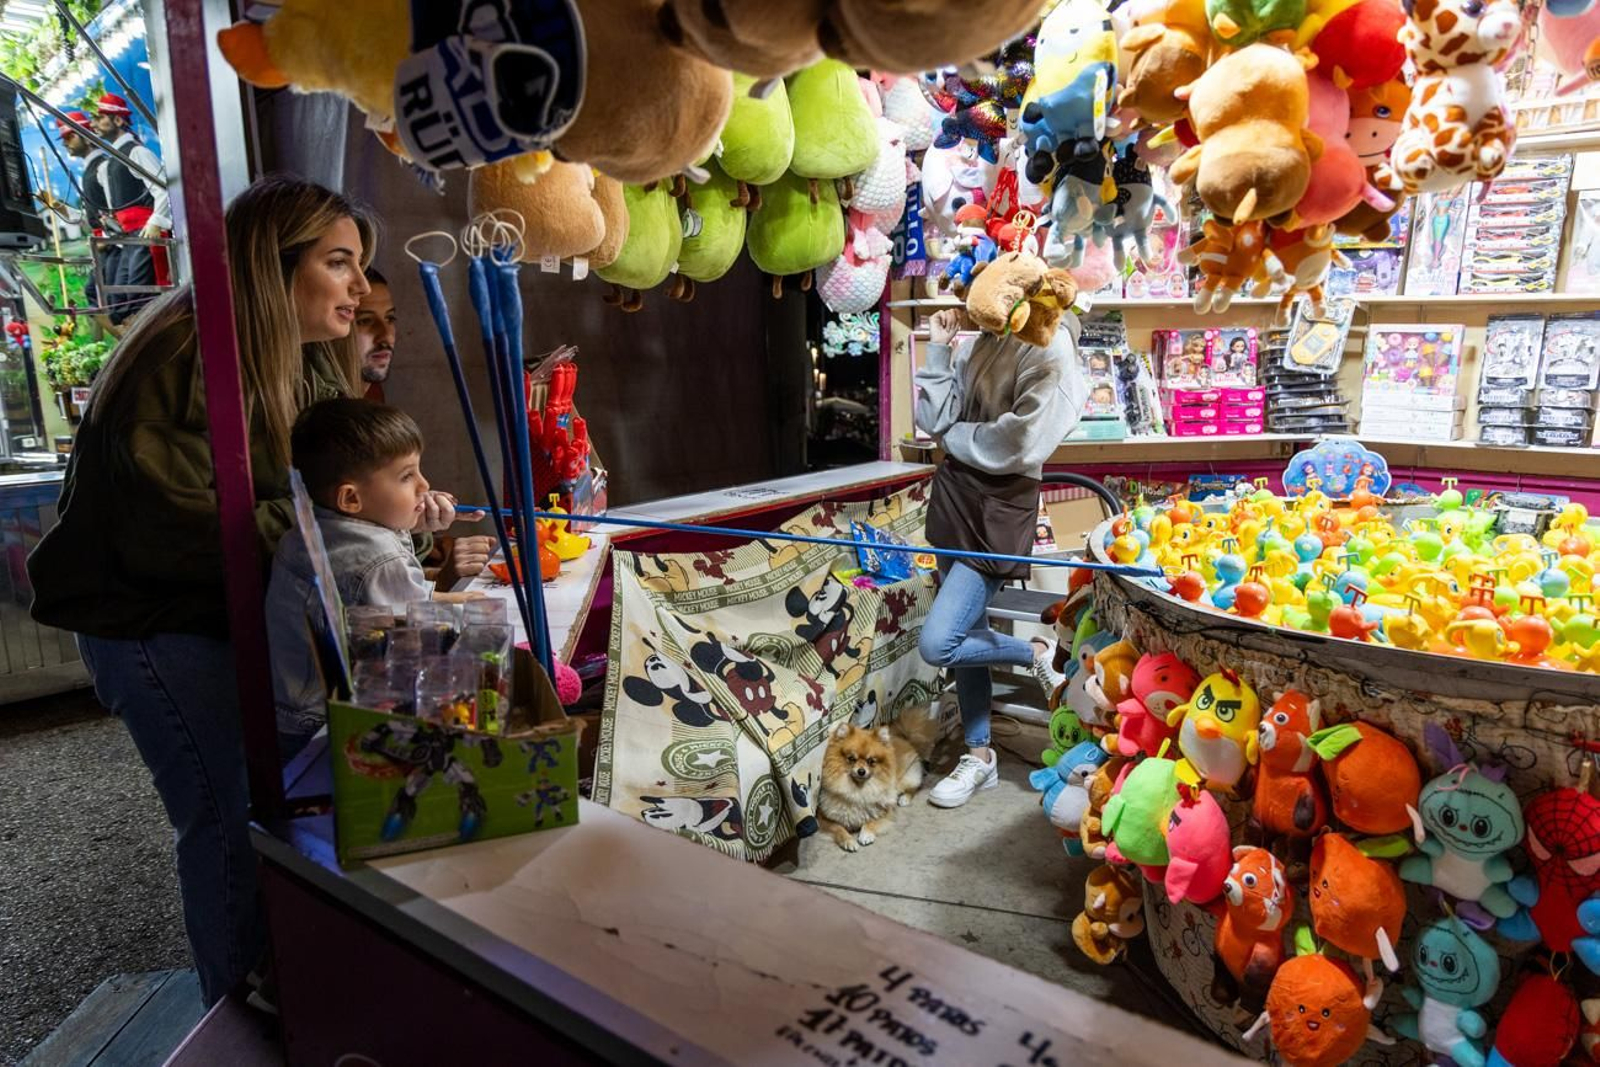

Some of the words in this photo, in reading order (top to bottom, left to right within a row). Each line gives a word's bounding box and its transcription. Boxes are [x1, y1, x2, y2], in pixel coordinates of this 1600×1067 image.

[674, 590, 697, 602] MICKEY
[698, 587, 717, 600] MOUSE
[744, 577, 762, 590] MOUSE
[700, 599, 719, 612] MOUSE
[727, 593, 749, 606] MICKEY
[749, 588, 769, 601] MOUSE
[606, 659, 619, 684] MOUSE
[603, 684, 617, 711] MICKEY
[600, 718, 614, 741] MOUSE
[599, 743, 612, 764] MICKEY
[879, 965, 914, 993] 4
[906, 987, 987, 1037] PATOS
[824, 984, 881, 1012] 10
[867, 1008, 938, 1056] PATOS
